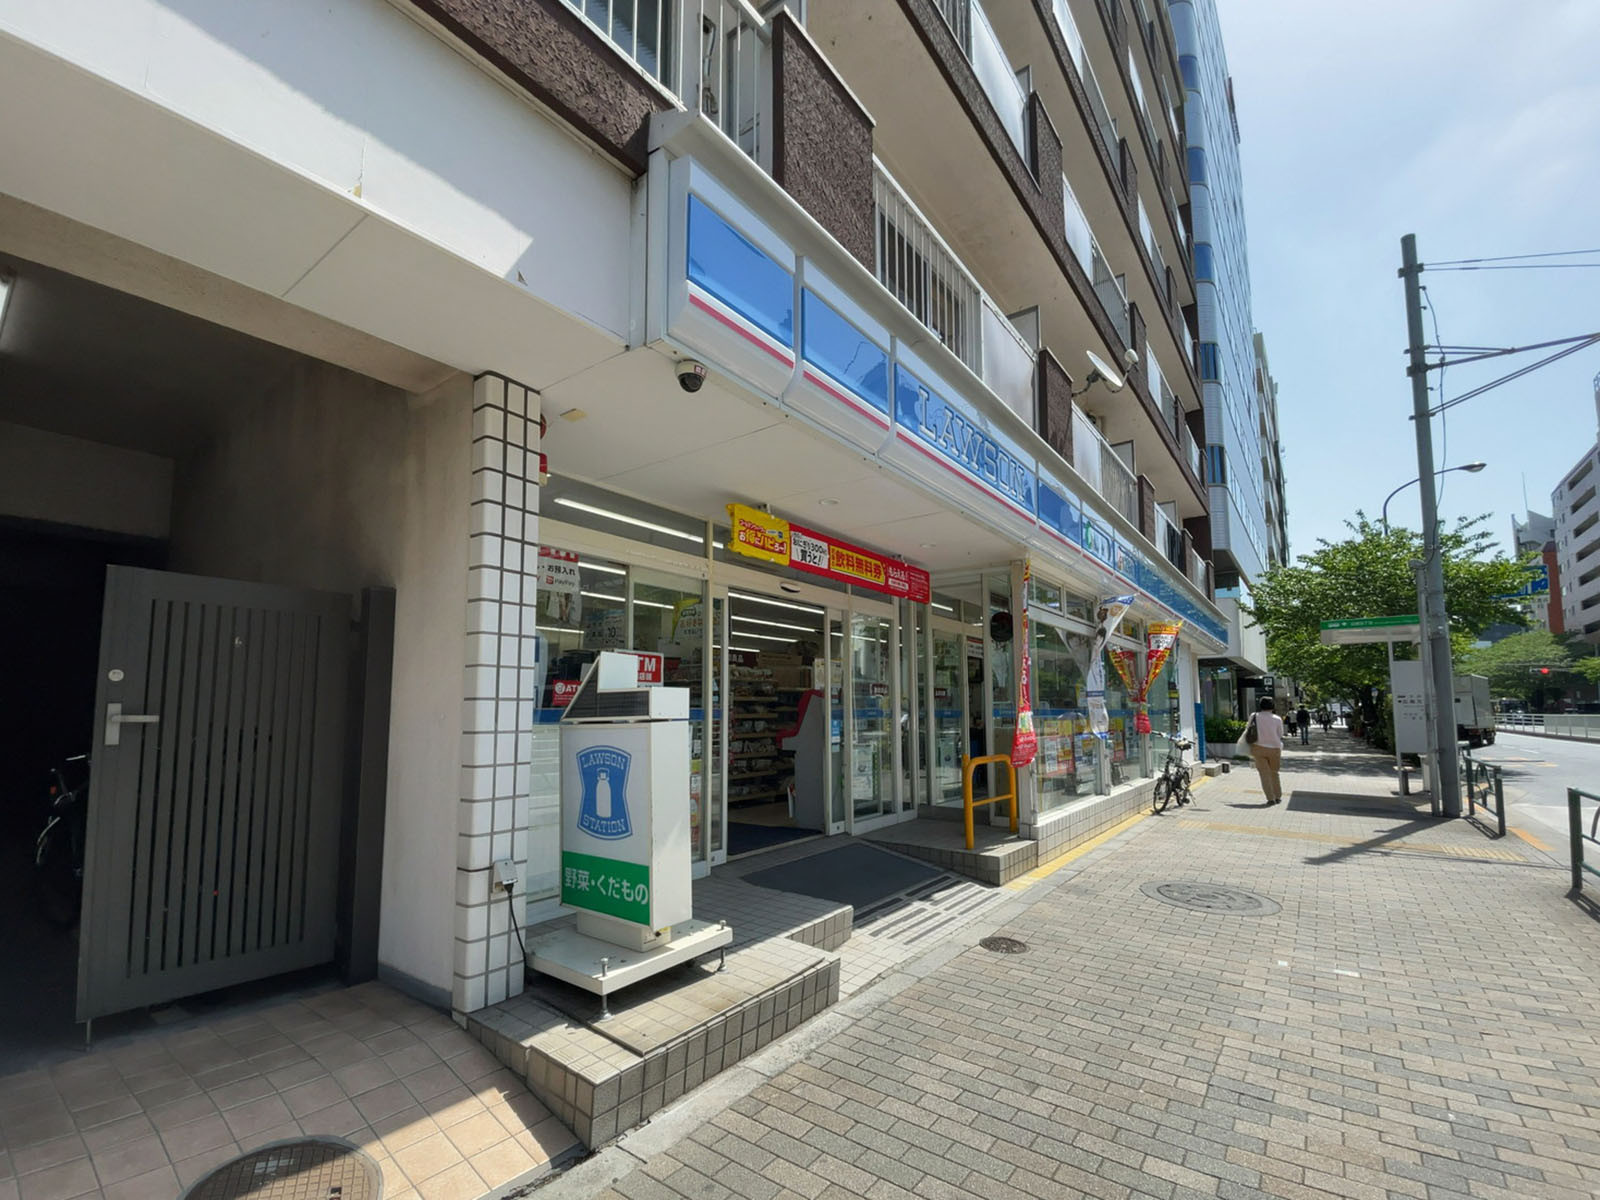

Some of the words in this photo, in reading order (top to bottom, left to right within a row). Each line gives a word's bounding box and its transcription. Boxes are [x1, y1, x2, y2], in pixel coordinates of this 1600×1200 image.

[919, 385, 1025, 503] LAWSON
[637, 656, 657, 672] TM
[582, 752, 626, 770] LAWSON
[583, 814, 626, 833] STATION
[564, 867, 649, 905] 野菜・くだもの
